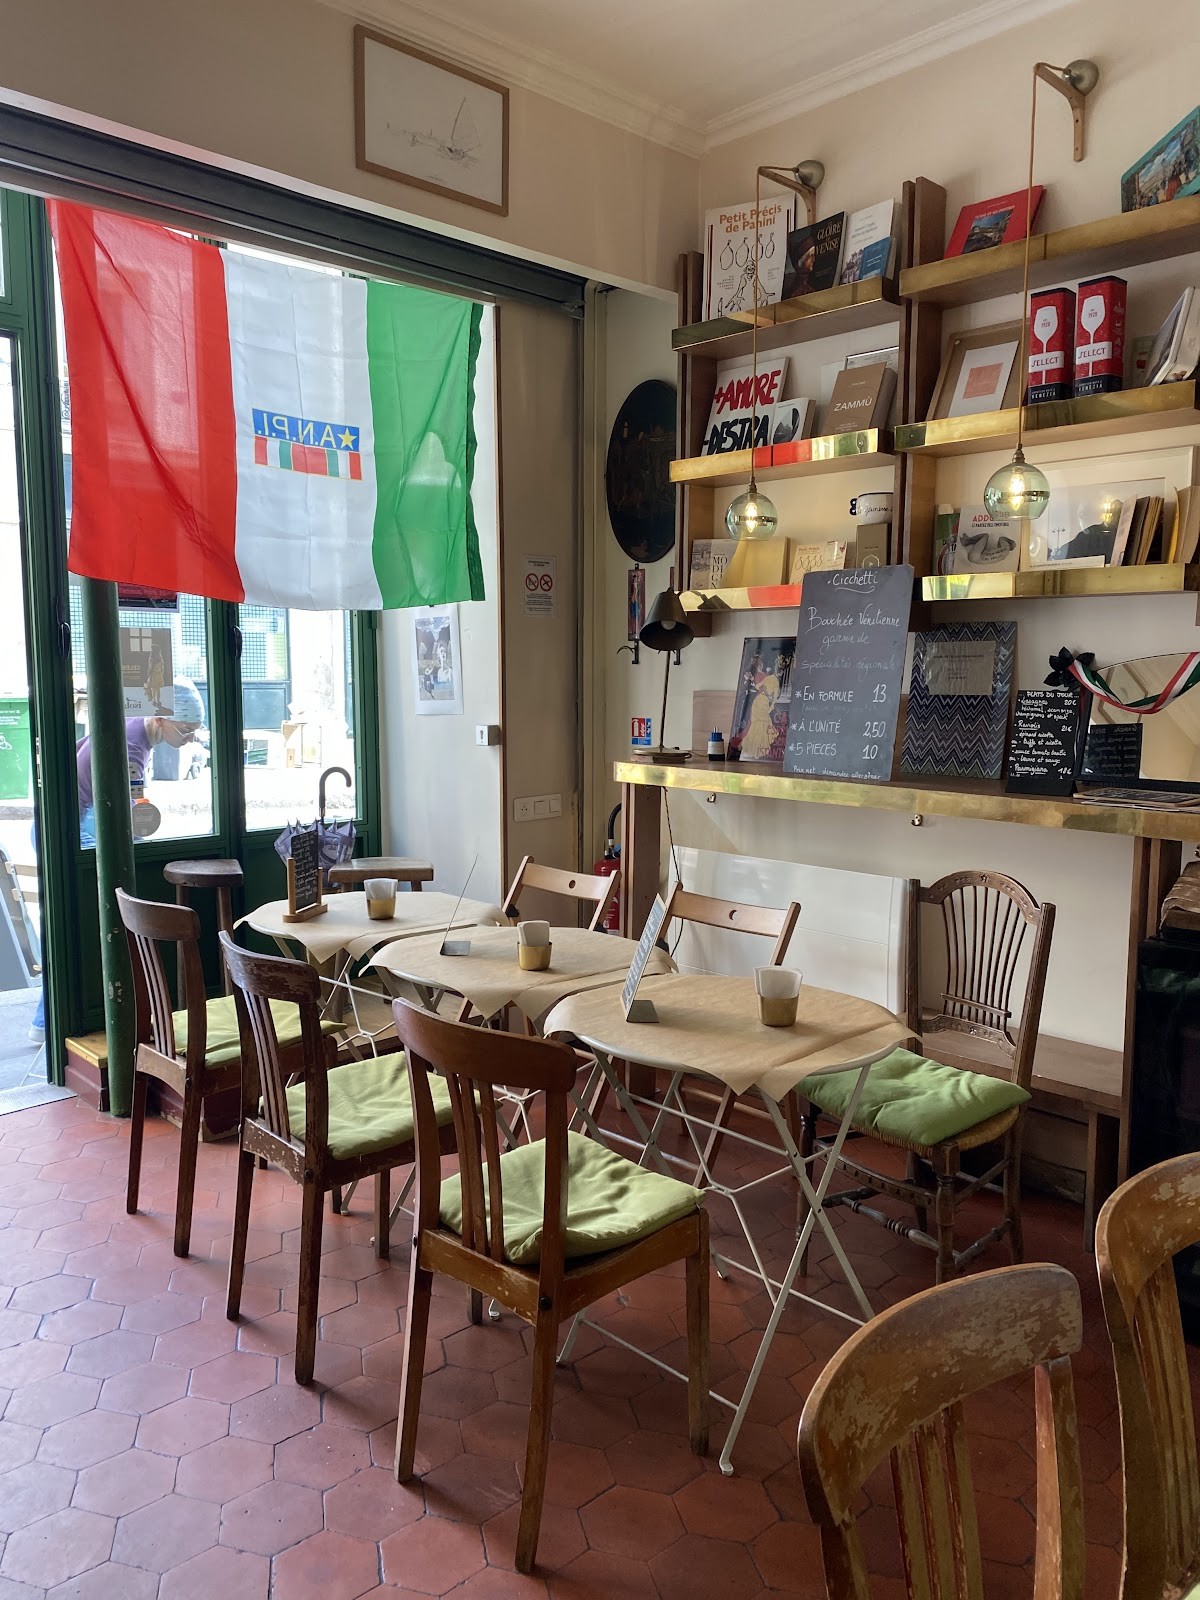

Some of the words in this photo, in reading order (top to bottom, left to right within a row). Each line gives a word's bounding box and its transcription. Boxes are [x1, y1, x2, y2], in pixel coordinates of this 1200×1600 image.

[720, 211, 747, 224] Petit
[750, 203, 782, 219] Précis
[725, 223, 739, 234] de
[743, 216, 776, 230] Panini
[817, 221, 842, 240] GLOIRE
[815, 237, 840, 255] VENISE
[1031, 356, 1059, 367] SELECT
[1078, 347, 1106, 359] SELECT
[833, 571, 878, 586] Cicchetti
[858, 632, 870, 644] de
[819, 690, 854, 702] FORMULE
[872, 684, 887, 703] 13
[795, 743, 803, 755] 5
[862, 745, 878, 760] 10
